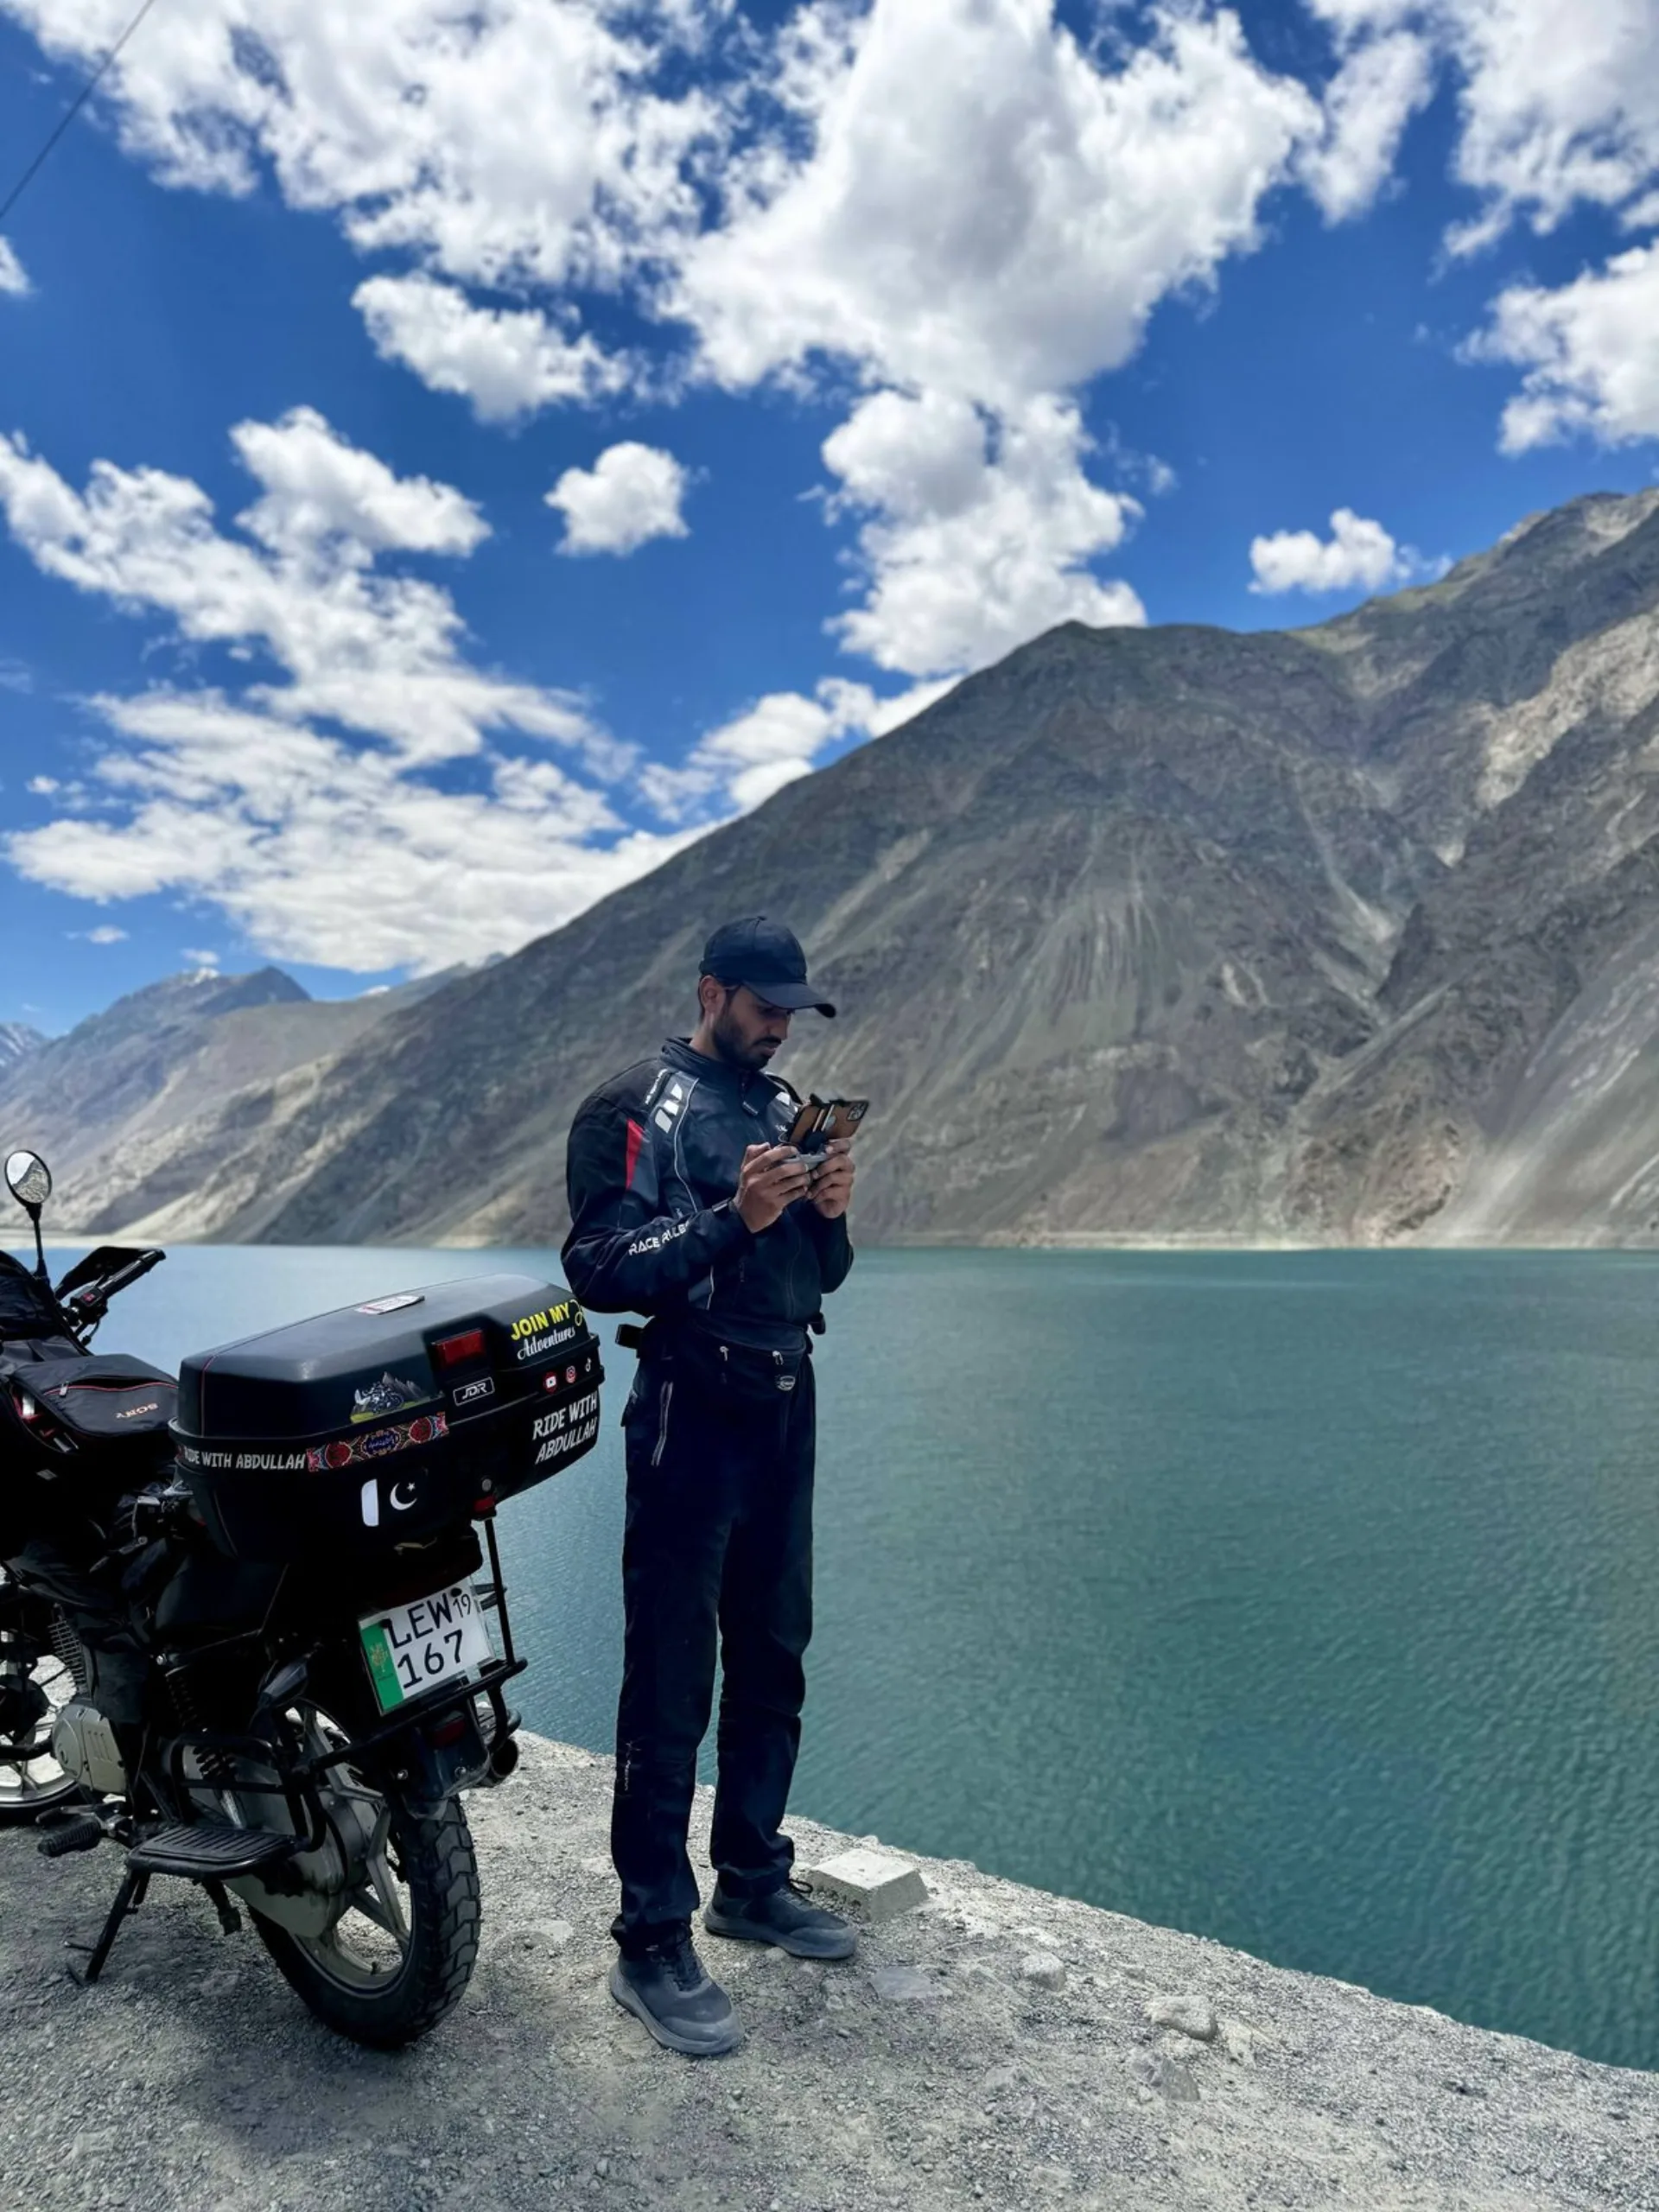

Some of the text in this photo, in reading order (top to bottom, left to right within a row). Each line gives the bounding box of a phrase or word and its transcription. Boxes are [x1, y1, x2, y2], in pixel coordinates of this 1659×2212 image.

[628, 1236, 661, 1255] RACE
[511, 1302, 570, 1341] JOIN MY
[462, 1382, 487, 1400] JDR
[532, 1391, 598, 1440] RIDE WITH
[201, 1451, 232, 1468] WITH
[235, 1453, 306, 1470] ABDULLAH
[535, 1416, 598, 1465] ABDULLAH
[386, 1592, 472, 1649] LEW 19
[397, 1629, 464, 1689] 167
